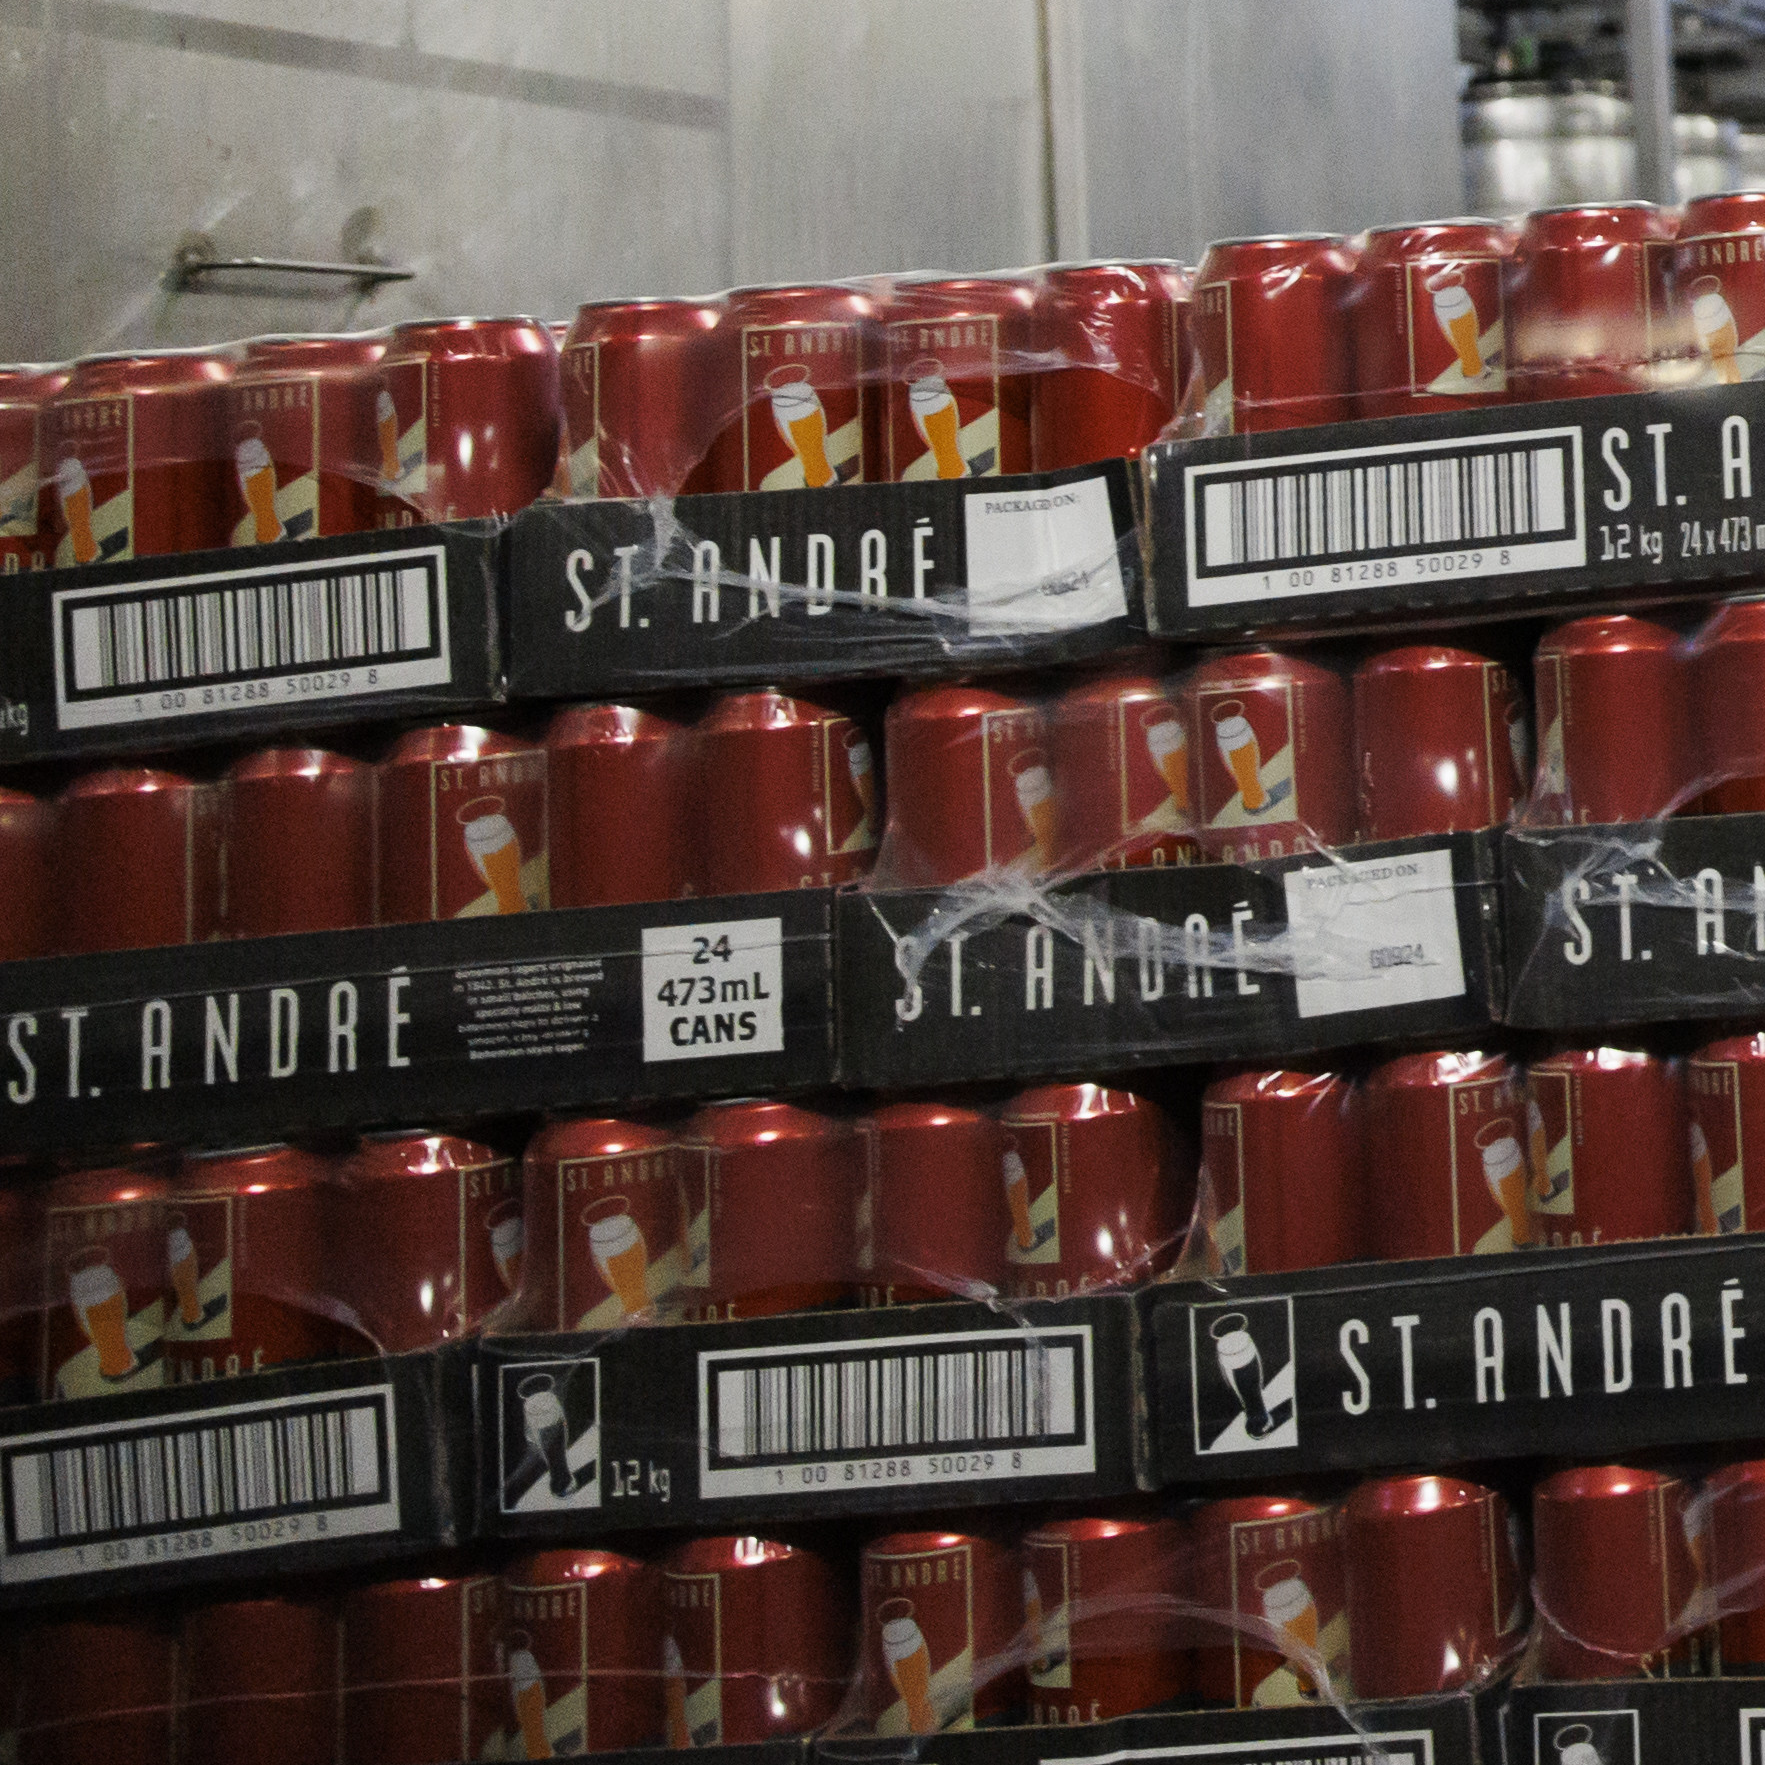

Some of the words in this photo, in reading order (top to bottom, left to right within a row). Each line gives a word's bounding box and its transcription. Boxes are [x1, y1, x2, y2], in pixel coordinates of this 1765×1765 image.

[1601, 422, 1687, 512] ST.
[1600, 523, 1633, 560] 12
[1639, 519, 1663, 565] kg
[1680, 521, 1702, 558] 24
[1705, 529, 1716, 553] x
[1720, 515, 1751, 552] 473
[565, 544, 650, 632] ST.
[692, 517, 935, 624] ANDRÉ
[1288, 570, 1315, 588] 00
[1331, 561, 1398, 583] 81288
[1415, 552, 1483, 575] 50029
[1500, 549, 1511, 566] 8
[160, 692, 187, 711] 00
[202, 681, 271, 705] 81288
[286, 671, 351, 695] 50029
[367, 667, 378, 685] 8
[1562, 873, 1652, 966] ST.
[692, 934, 733, 965] 24
[895, 935, 982, 1023] ST.
[1025, 900, 1262, 1012] ANDRÉ
[656, 971, 770, 1008] 473mL
[7, 1004, 102, 1105] ST.
[141, 966, 411, 1091] ANDRÉ
[669, 1011, 758, 1047] CANS
[1339, 1313, 1437, 1416] ST.
[1472, 1277, 1748, 1405] ANDRÉ
[610, 1460, 641, 1498] 12
[648, 1459, 672, 1502] kg
[802, 1465, 827, 1484] 00
[844, 1459, 911, 1482] 81288
[929, 1454, 994, 1476] 50029
[1012, 1451, 1022, 1469] 8
